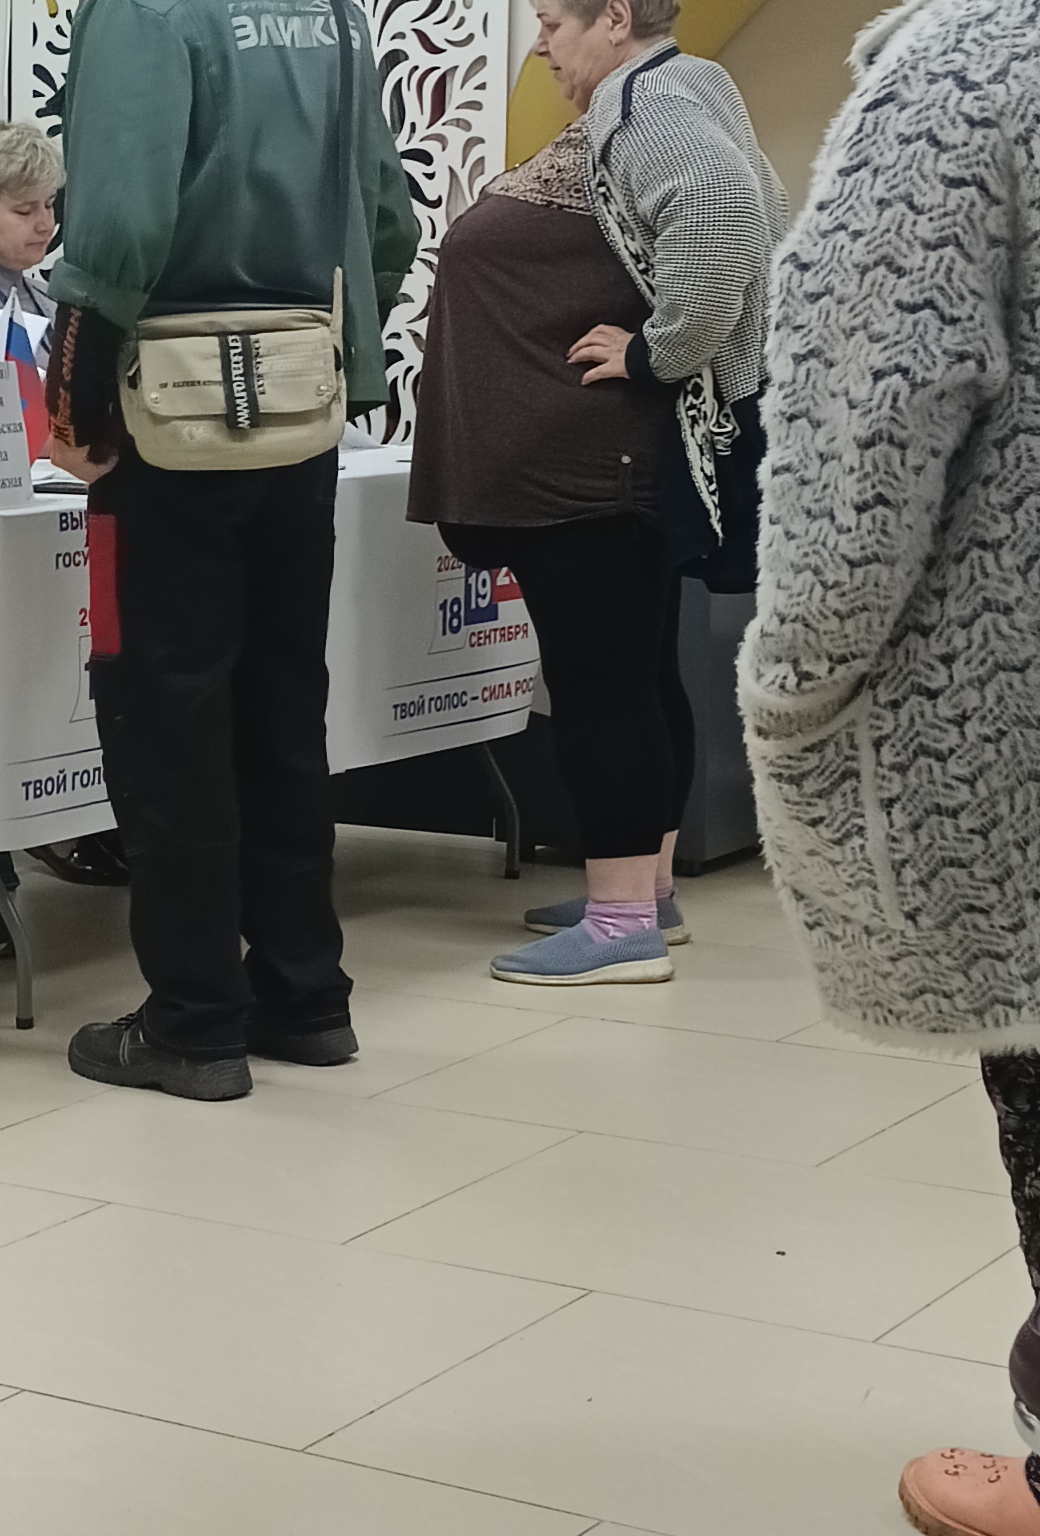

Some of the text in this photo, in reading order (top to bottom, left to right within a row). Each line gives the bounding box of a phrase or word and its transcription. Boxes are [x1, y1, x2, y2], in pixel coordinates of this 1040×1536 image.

[439, 566, 518, 636] 18 19 2
[468, 623, 529, 648] СЕНТЯБРЯ
[392, 694, 425, 721] ТВОЙ
[427, 690, 468, 714] ГОЛОС
[481, 682, 512, 703] СИЛА
[22, 768, 67, 801] ТВОЙ
